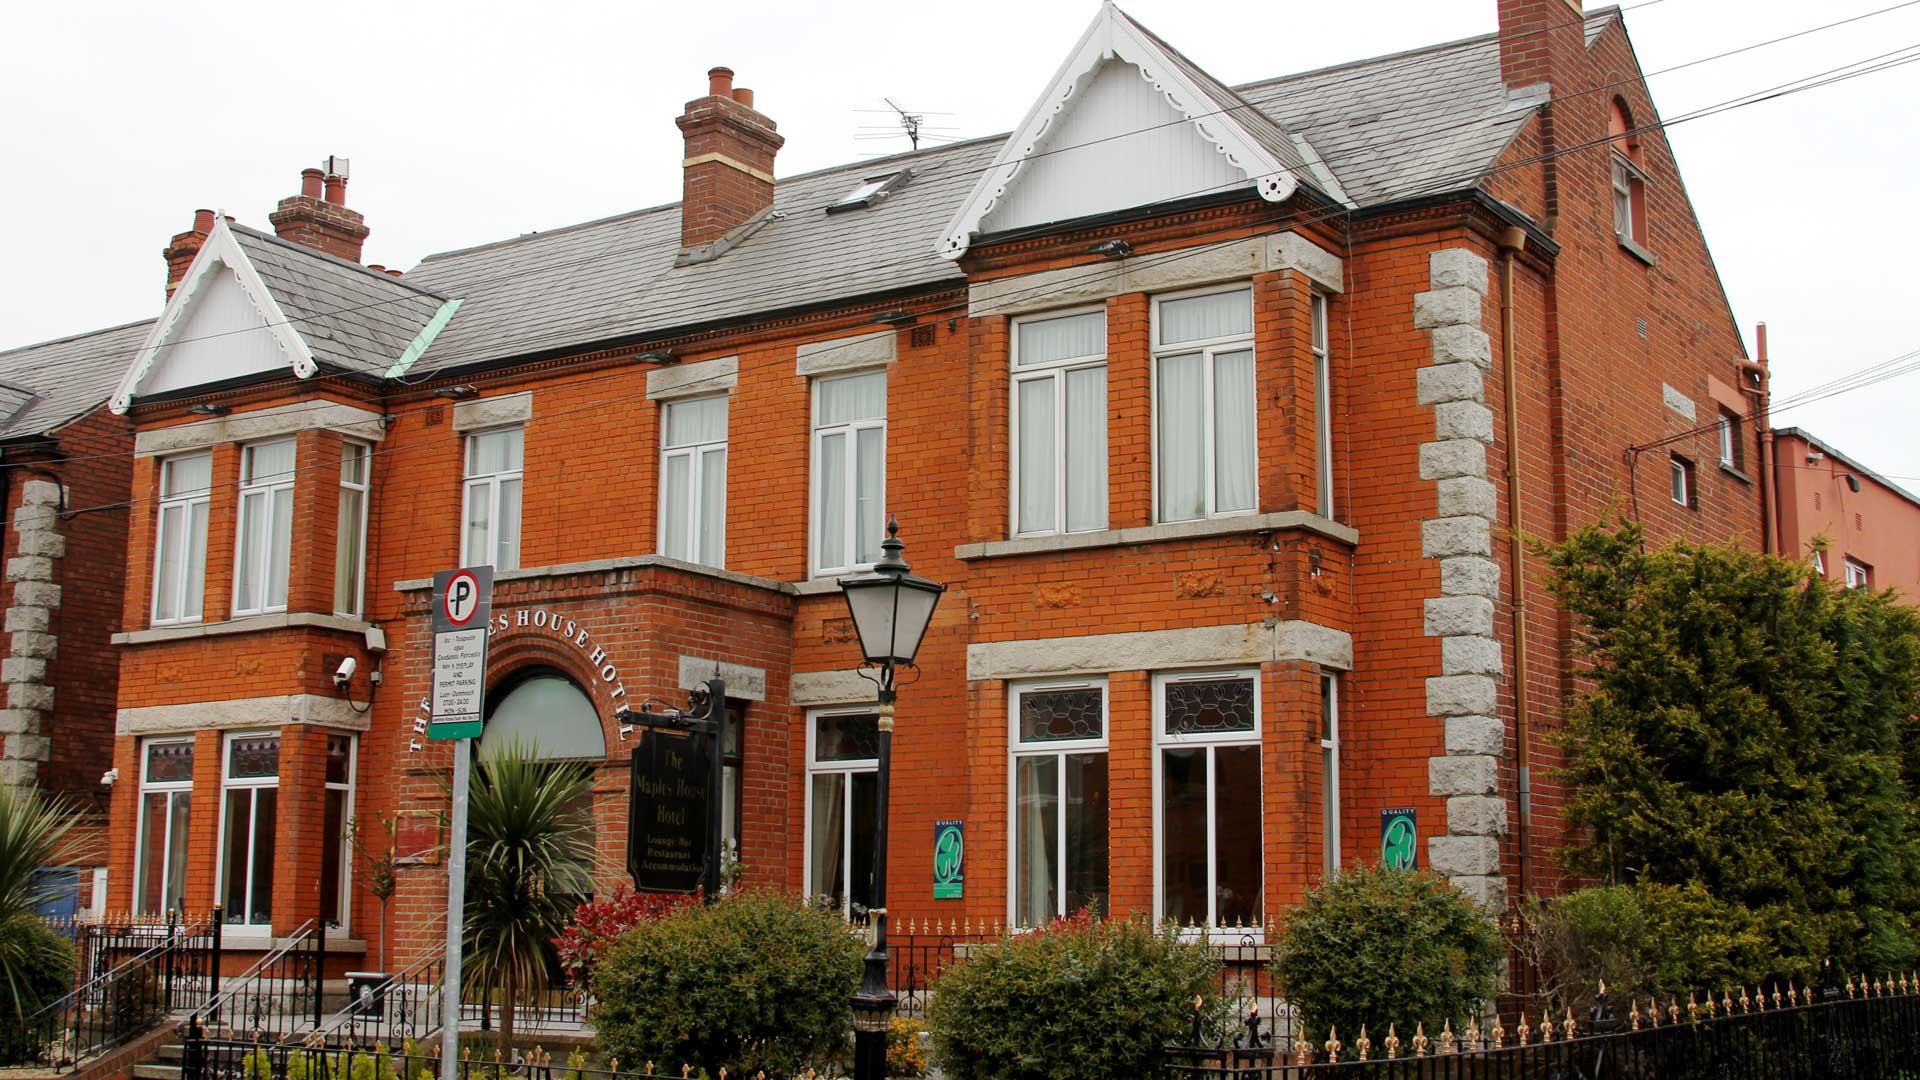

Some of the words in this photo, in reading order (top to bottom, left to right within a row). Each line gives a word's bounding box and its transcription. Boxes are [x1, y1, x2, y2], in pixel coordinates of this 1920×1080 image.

[455, 581, 470, 616] P
[517, 609, 589, 649] HOUSE
[456, 679, 476, 687] PARKING
[665, 750, 684, 770] The
[637, 774, 673, 799] Maples
[676, 778, 706, 800] House
[657, 803, 686, 826] Hotel
[647, 847, 691, 860] Restaurant
[641, 860, 706, 873] Accommodation
